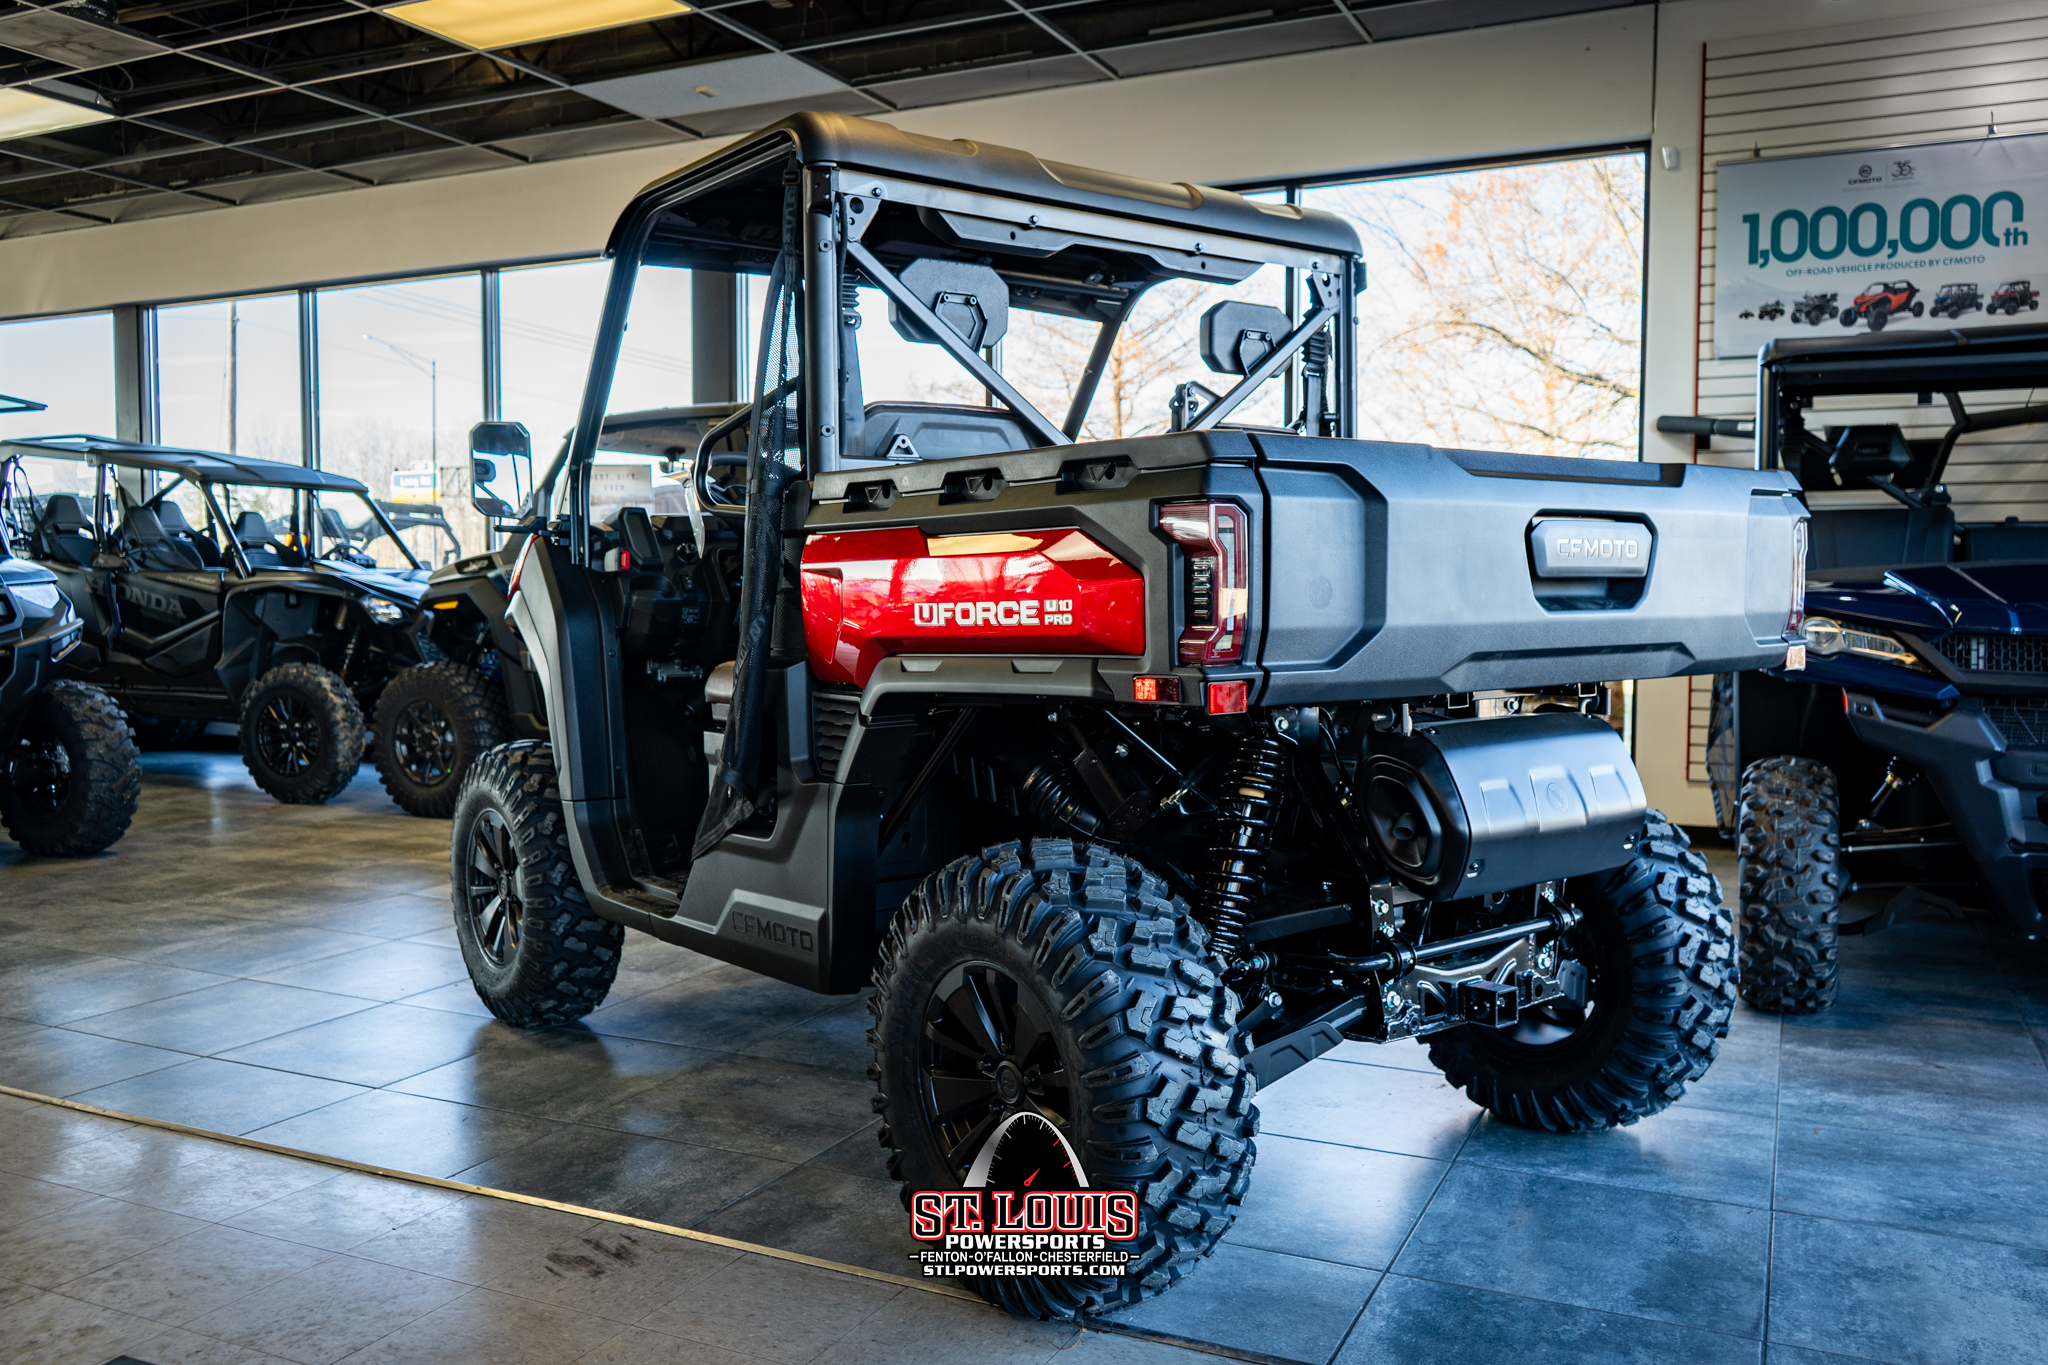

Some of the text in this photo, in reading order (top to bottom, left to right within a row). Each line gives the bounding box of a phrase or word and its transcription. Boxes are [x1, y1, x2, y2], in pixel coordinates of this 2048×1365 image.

[1786, 255, 1985, 277] OFF-ROAD VEHICLE PRODUCED BY CFMOTO
[1556, 538, 1639, 559] CFMOTO
[914, 599, 1073, 627] UFORCE U10
[1043, 613, 1073, 626] PRO
[732, 910, 814, 953] CFMOTO
